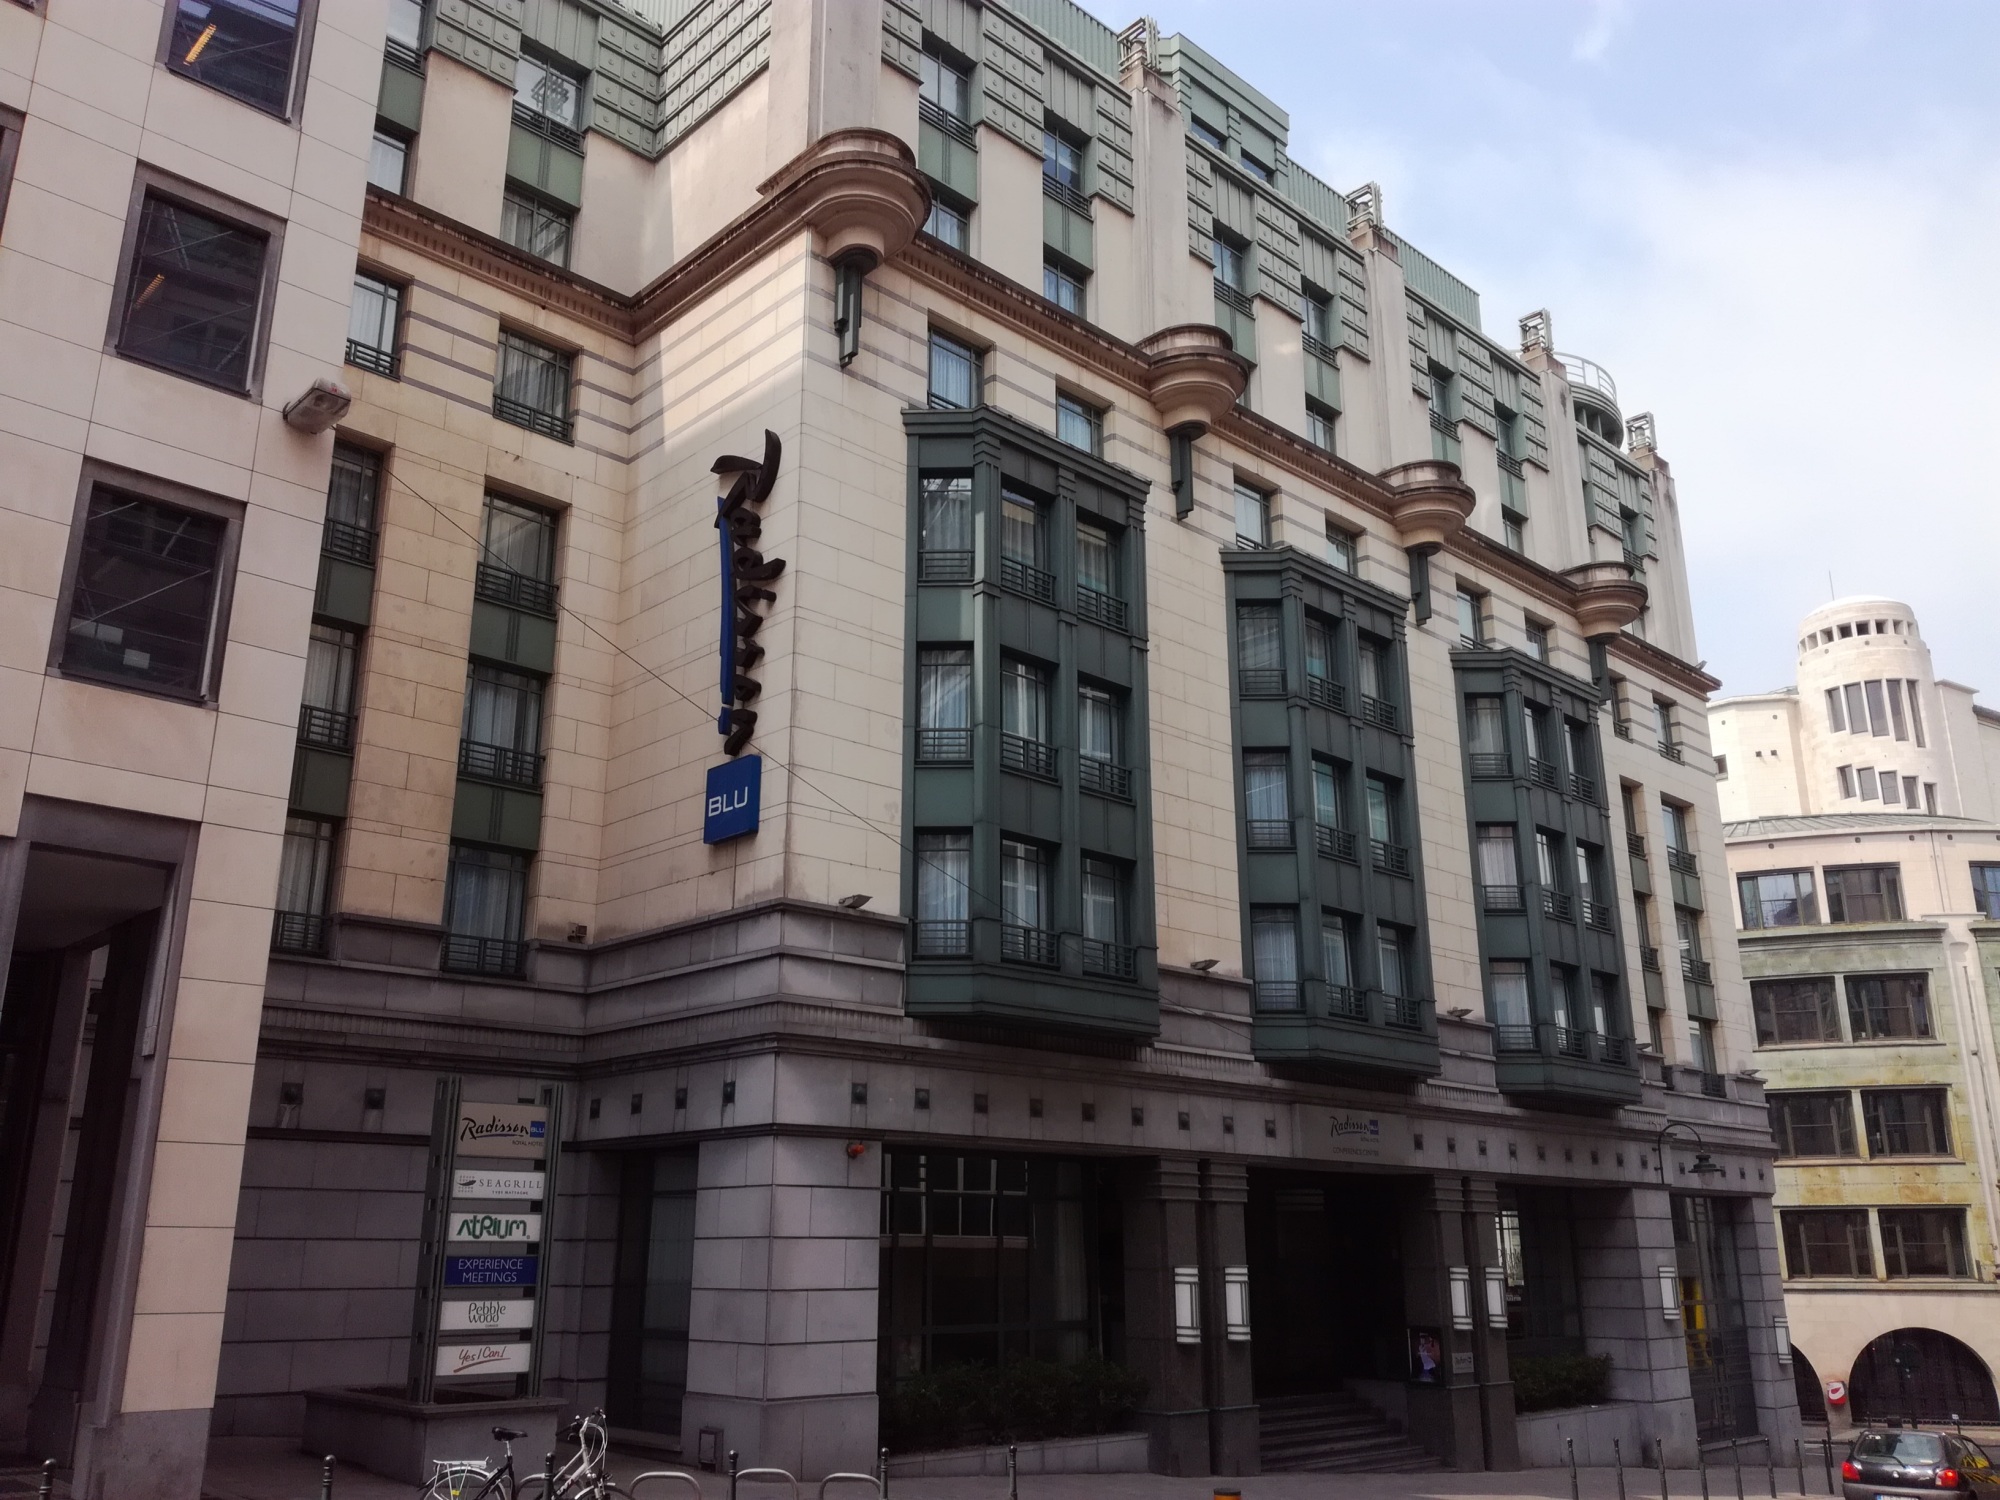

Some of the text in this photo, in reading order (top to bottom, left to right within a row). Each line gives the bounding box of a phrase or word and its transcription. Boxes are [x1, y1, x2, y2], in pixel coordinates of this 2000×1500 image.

[708, 786, 748, 818] BLU
[460, 1115, 529, 1142] Radisson
[1329, 1114, 1369, 1138] Radisson
[479, 1179, 542, 1189] SEAGRILL
[458, 1258, 523, 1270] EXPERIENCE
[462, 1271, 517, 1283] MEETINGS
[468, 1301, 506, 1316] Pebble
[459, 1348, 476, 1365] Yes
